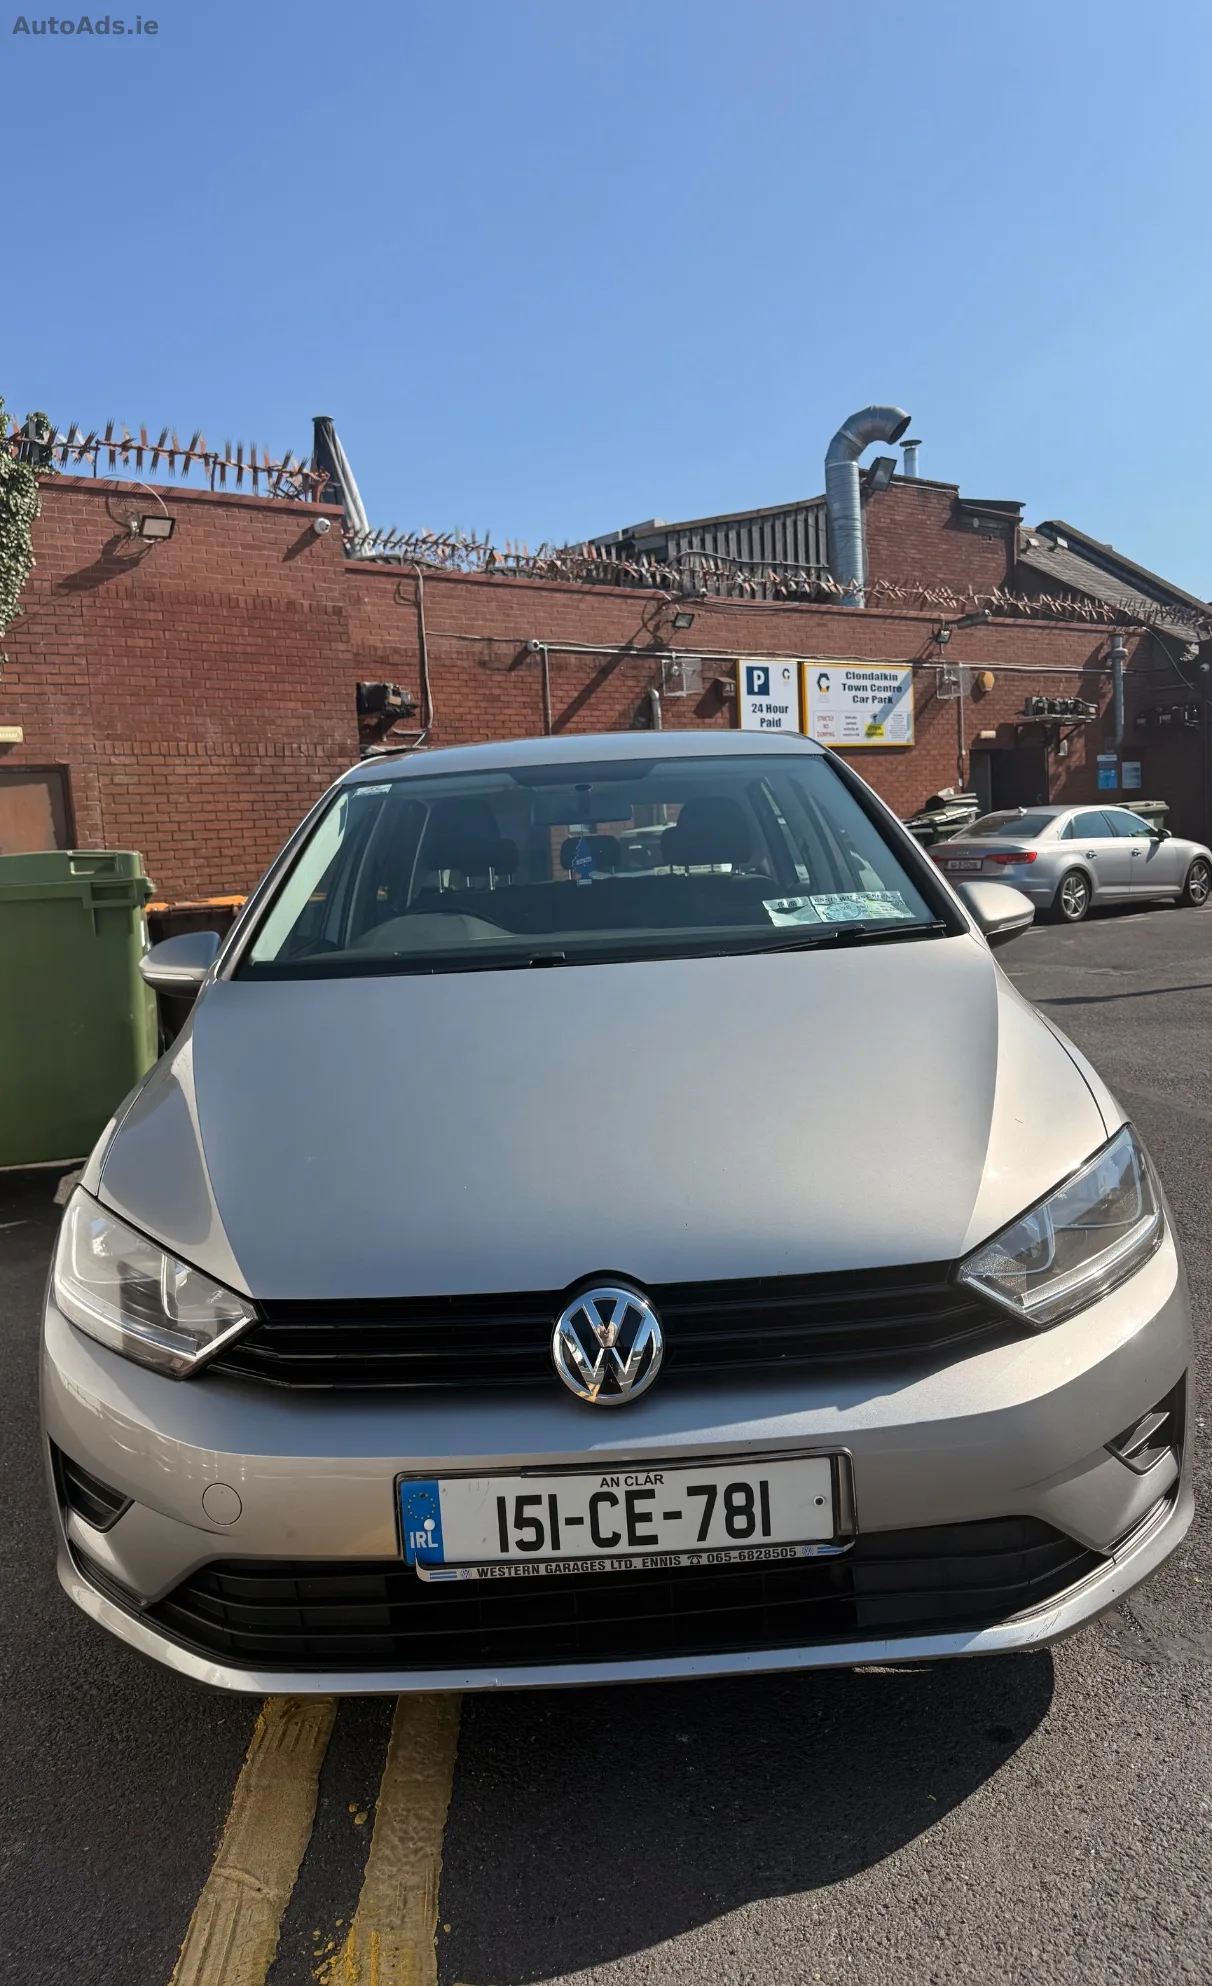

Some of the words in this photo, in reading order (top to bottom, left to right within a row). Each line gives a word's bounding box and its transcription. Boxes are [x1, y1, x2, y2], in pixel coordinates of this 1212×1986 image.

[752, 670, 765, 692] P
[845, 671, 898, 681] Clondalkin
[841, 683, 868, 692] Town
[870, 684, 903, 693] Centre
[852, 695, 869, 704] Car
[871, 695, 893, 704] Park
[751, 703, 764, 714] 24
[766, 704, 789, 714] Hour
[760, 717, 781, 728] Paid
[600, 1476, 620, 1488] AN
[624, 1472, 664, 1487] CLÁR
[496, 1480, 771, 1553] 151-CE-781
[410, 1531, 438, 1548] IRL
[477, 1564, 540, 1578] WESTERN
[545, 1560, 606, 1574] GARAGES
[610, 1557, 637, 1570] LTD.
[642, 1555, 681, 1568] ENNIS
[707, 1546, 797, 1563] 065-6828505
